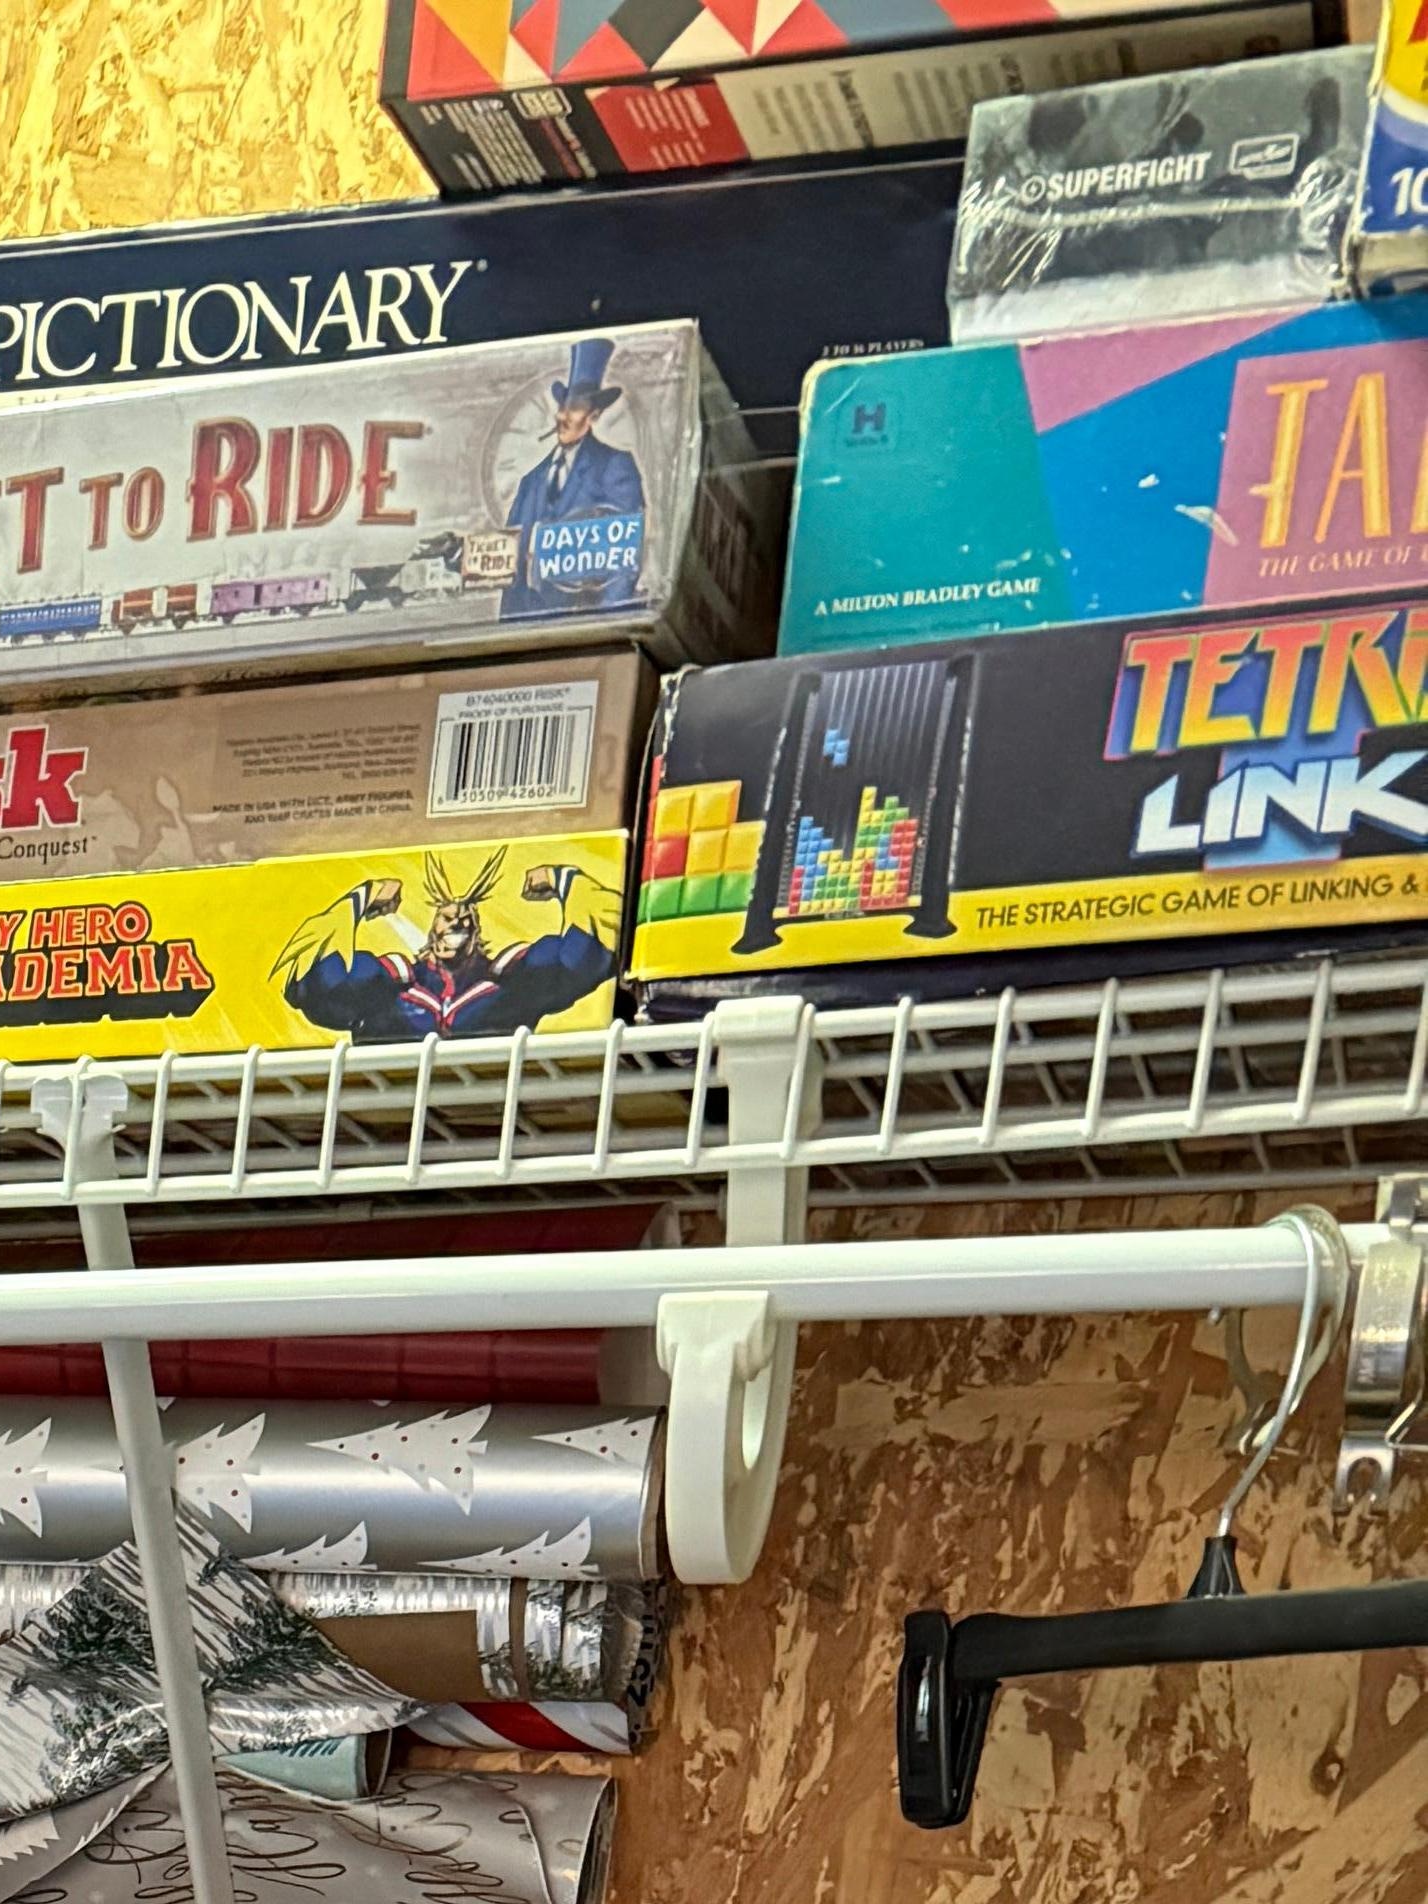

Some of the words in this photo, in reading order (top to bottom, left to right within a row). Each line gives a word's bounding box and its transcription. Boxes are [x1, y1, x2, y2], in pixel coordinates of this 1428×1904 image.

[1046, 152, 1212, 201] SUPERFIGHT
[79, 465, 165, 552] TO
[186, 418, 425, 543] RIDE
[1259, 372, 1428, 549] TA
[541, 524, 601, 550] DAYS
[606, 520, 640, 544] OF
[1257, 555, 1298, 577] THE
[1307, 551, 1373, 574] GAME
[1383, 545, 1412, 567] OF
[814, 600, 828, 617] A
[832, 592, 899, 614] MILTON
[902, 584, 984, 608] BRADLEY
[986, 577, 1041, 597] GAME
[1135, 749, 1428, 854] LINK
[30, 901, 149, 950] HERO
[976, 904, 1019, 930] THE
[1023, 894, 1156, 926] STRATEGIC
[1160, 886, 1242, 914] GAME
[1245, 881, 1286, 907] OF
[1289, 872, 1395, 904] LINKING
[1400, 872, 1419, 895] &
